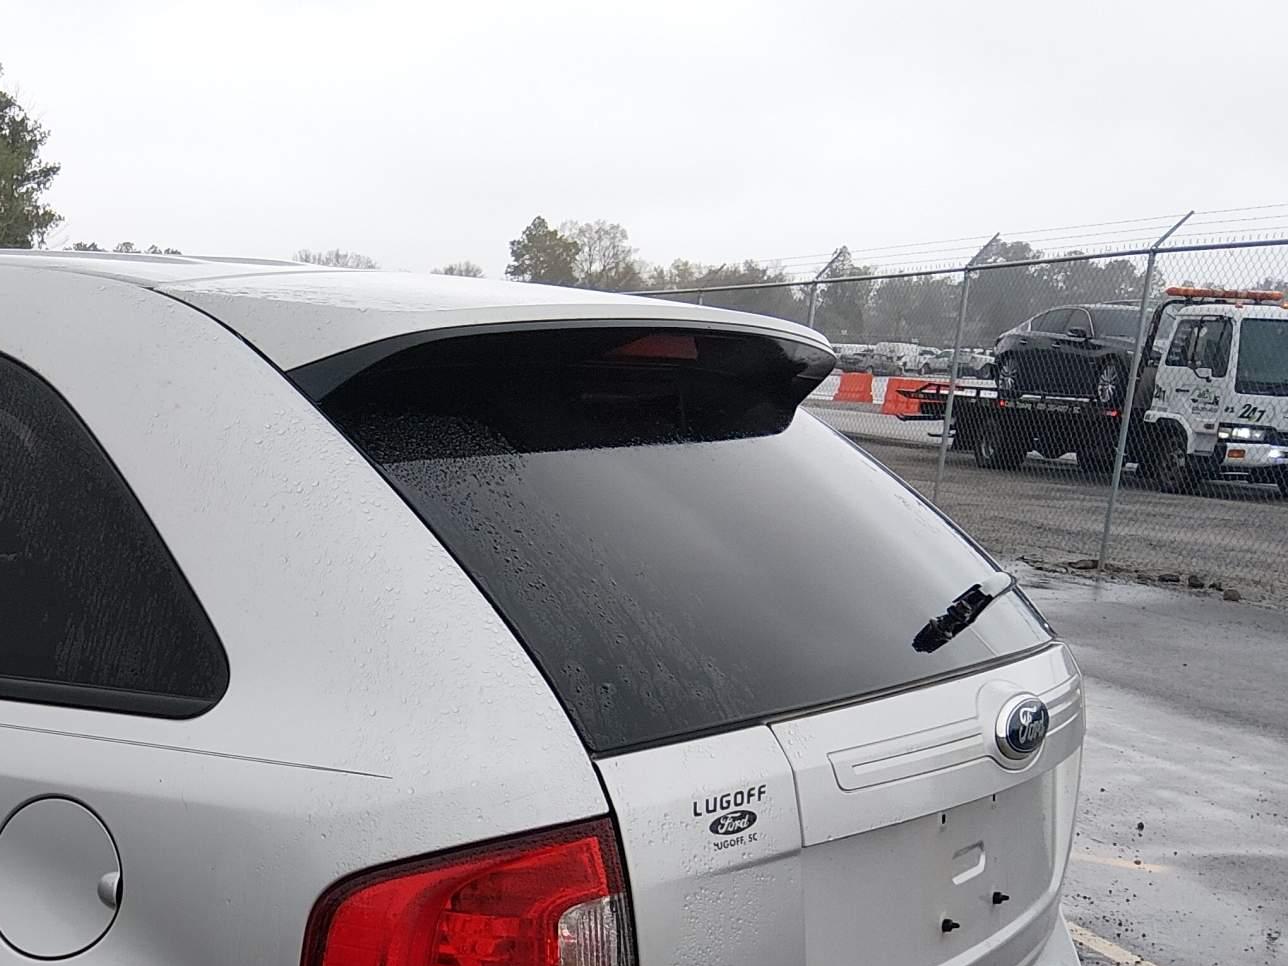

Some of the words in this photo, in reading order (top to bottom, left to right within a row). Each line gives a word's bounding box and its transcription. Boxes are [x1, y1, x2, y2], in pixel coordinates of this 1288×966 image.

[1018, 705, 1046, 745] Ford
[693, 784, 767, 817] LUGOFF
[716, 812, 751, 834] Ford
